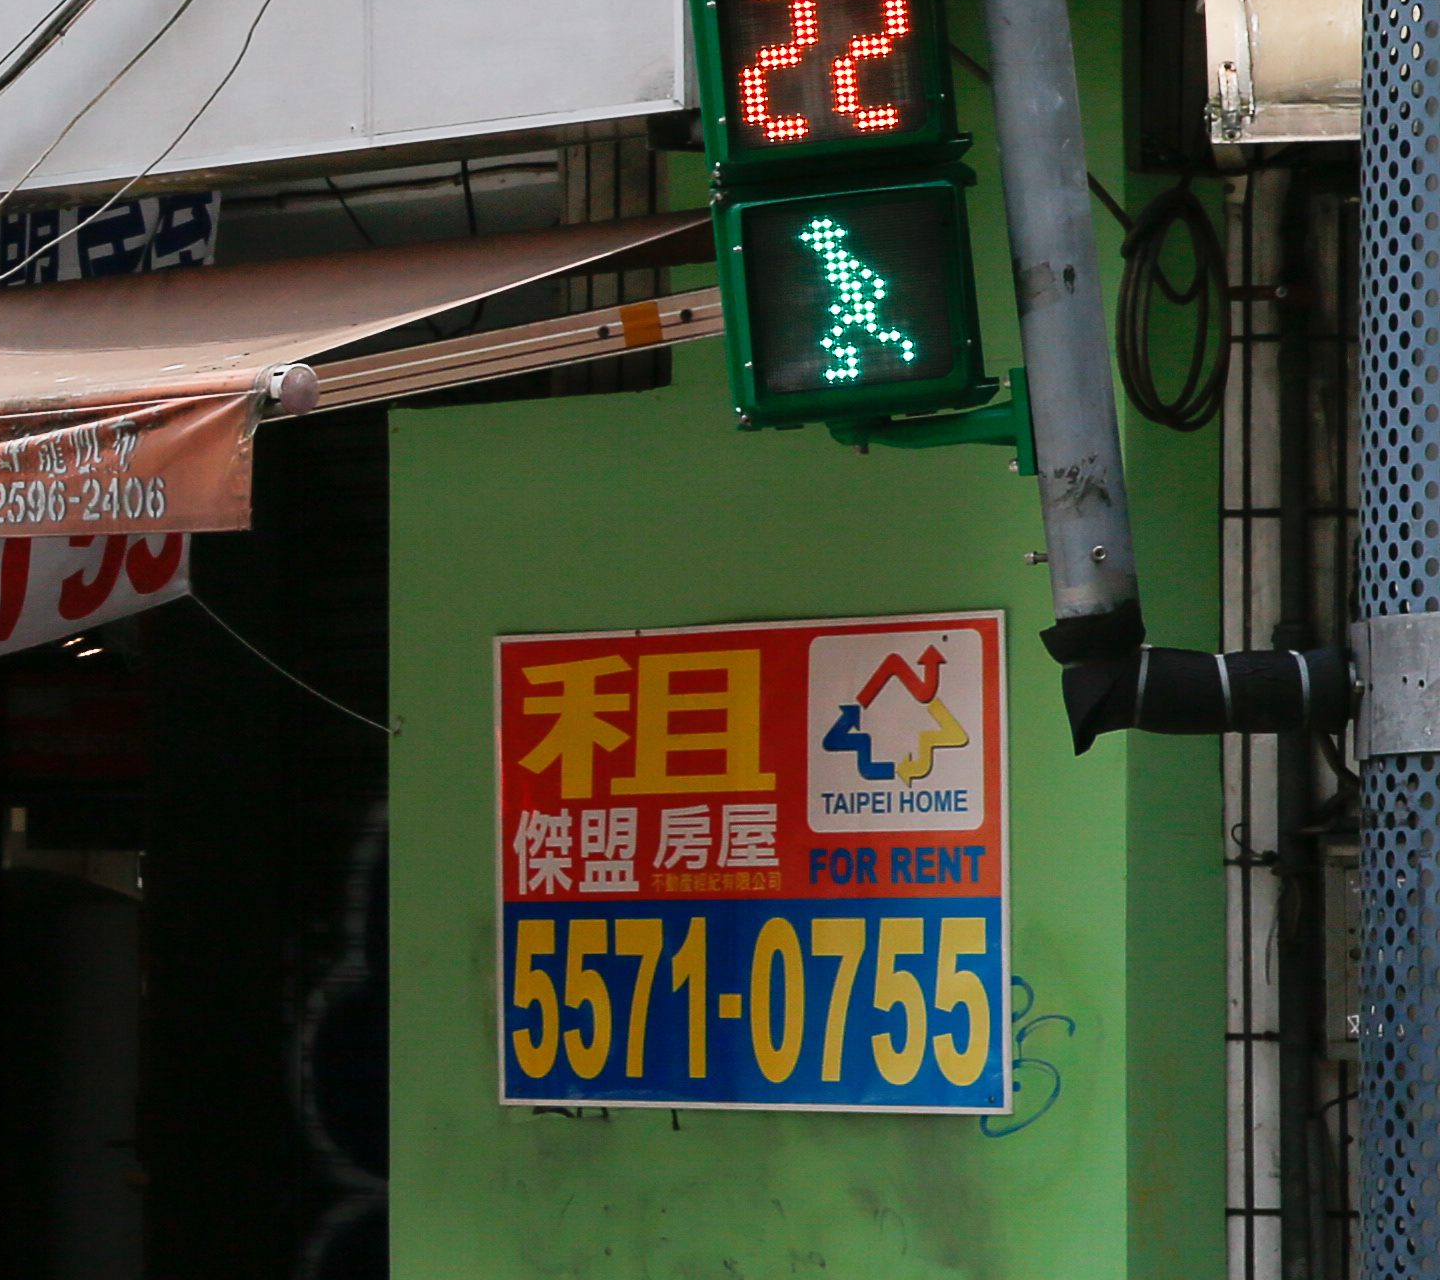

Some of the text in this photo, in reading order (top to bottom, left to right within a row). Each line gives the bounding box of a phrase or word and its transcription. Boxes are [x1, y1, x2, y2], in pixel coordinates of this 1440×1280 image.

[517, 649, 777, 800] 租
[821, 790, 968, 815] TAIPEI HOME
[651, 872, 782, 894] 不動產經紀有限公司
[810, 846, 986, 885] FOR RENT
[511, 917, 991, 1087] 5571-0755
